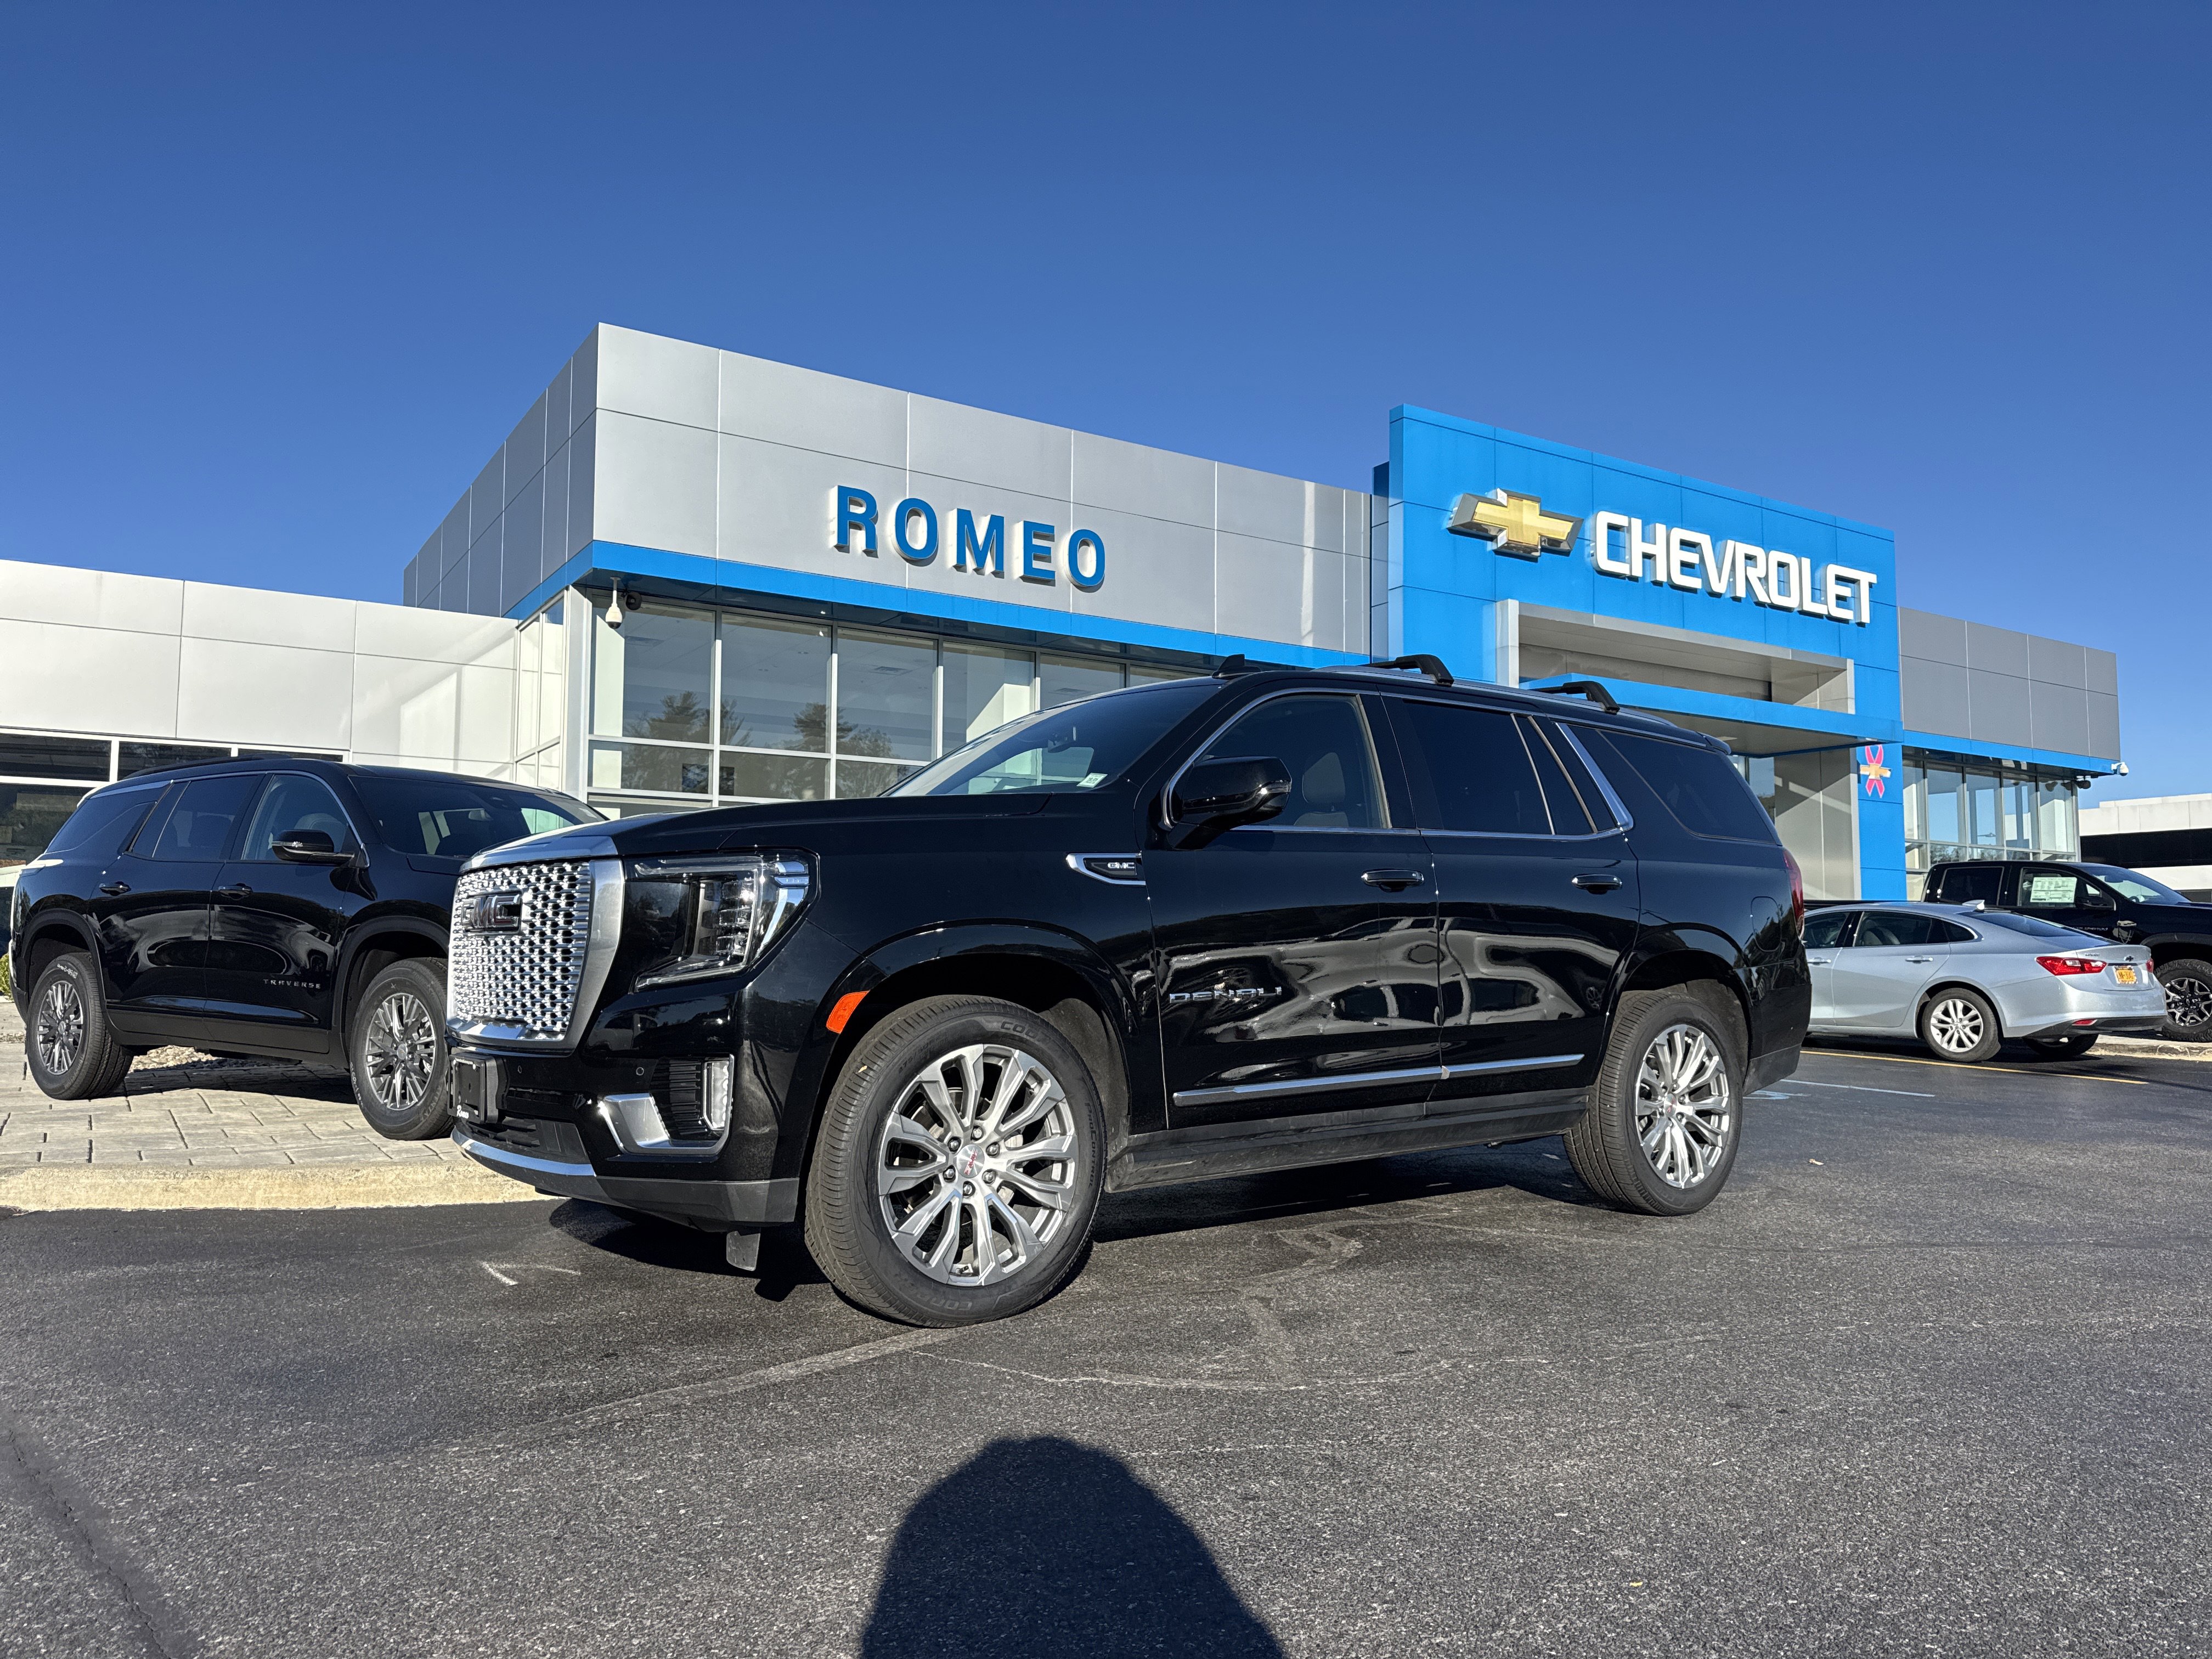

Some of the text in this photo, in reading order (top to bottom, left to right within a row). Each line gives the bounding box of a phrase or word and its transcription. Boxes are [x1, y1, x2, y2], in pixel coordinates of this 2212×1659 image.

[834, 484, 1105, 589] ROMEO
[1593, 510, 1877, 625] CHEVROLET
[461, 894, 520, 928] GMC
[263, 979, 321, 989] TRAVERSE
